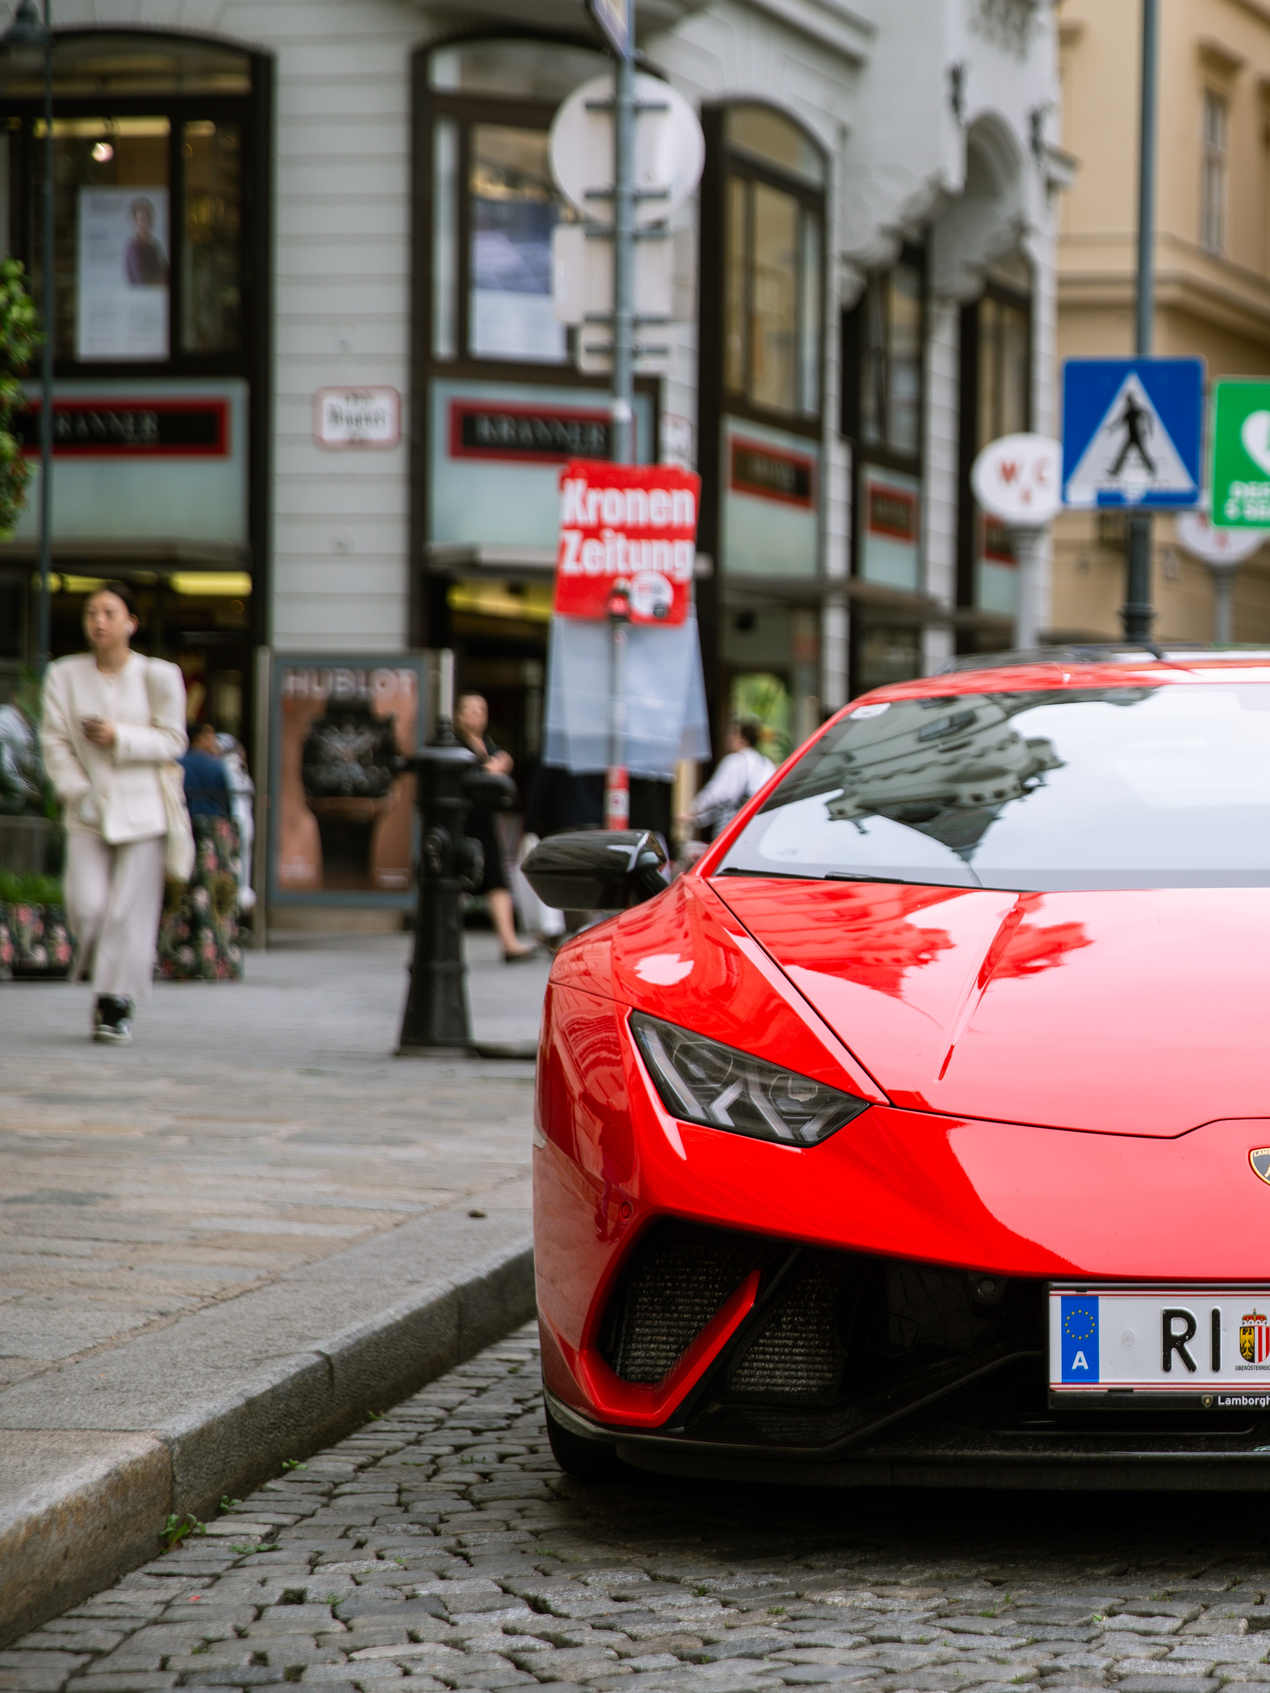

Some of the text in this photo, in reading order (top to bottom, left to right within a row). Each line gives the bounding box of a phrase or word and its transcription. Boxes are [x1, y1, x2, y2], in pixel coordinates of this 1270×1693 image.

[561, 478, 695, 527] Kronen
[561, 528, 695, 583] Zeitung
[282, 668, 418, 698] HUBLOT
[1071, 1350, 1089, 1370] A
[1162, 1307, 1221, 1373] RI
